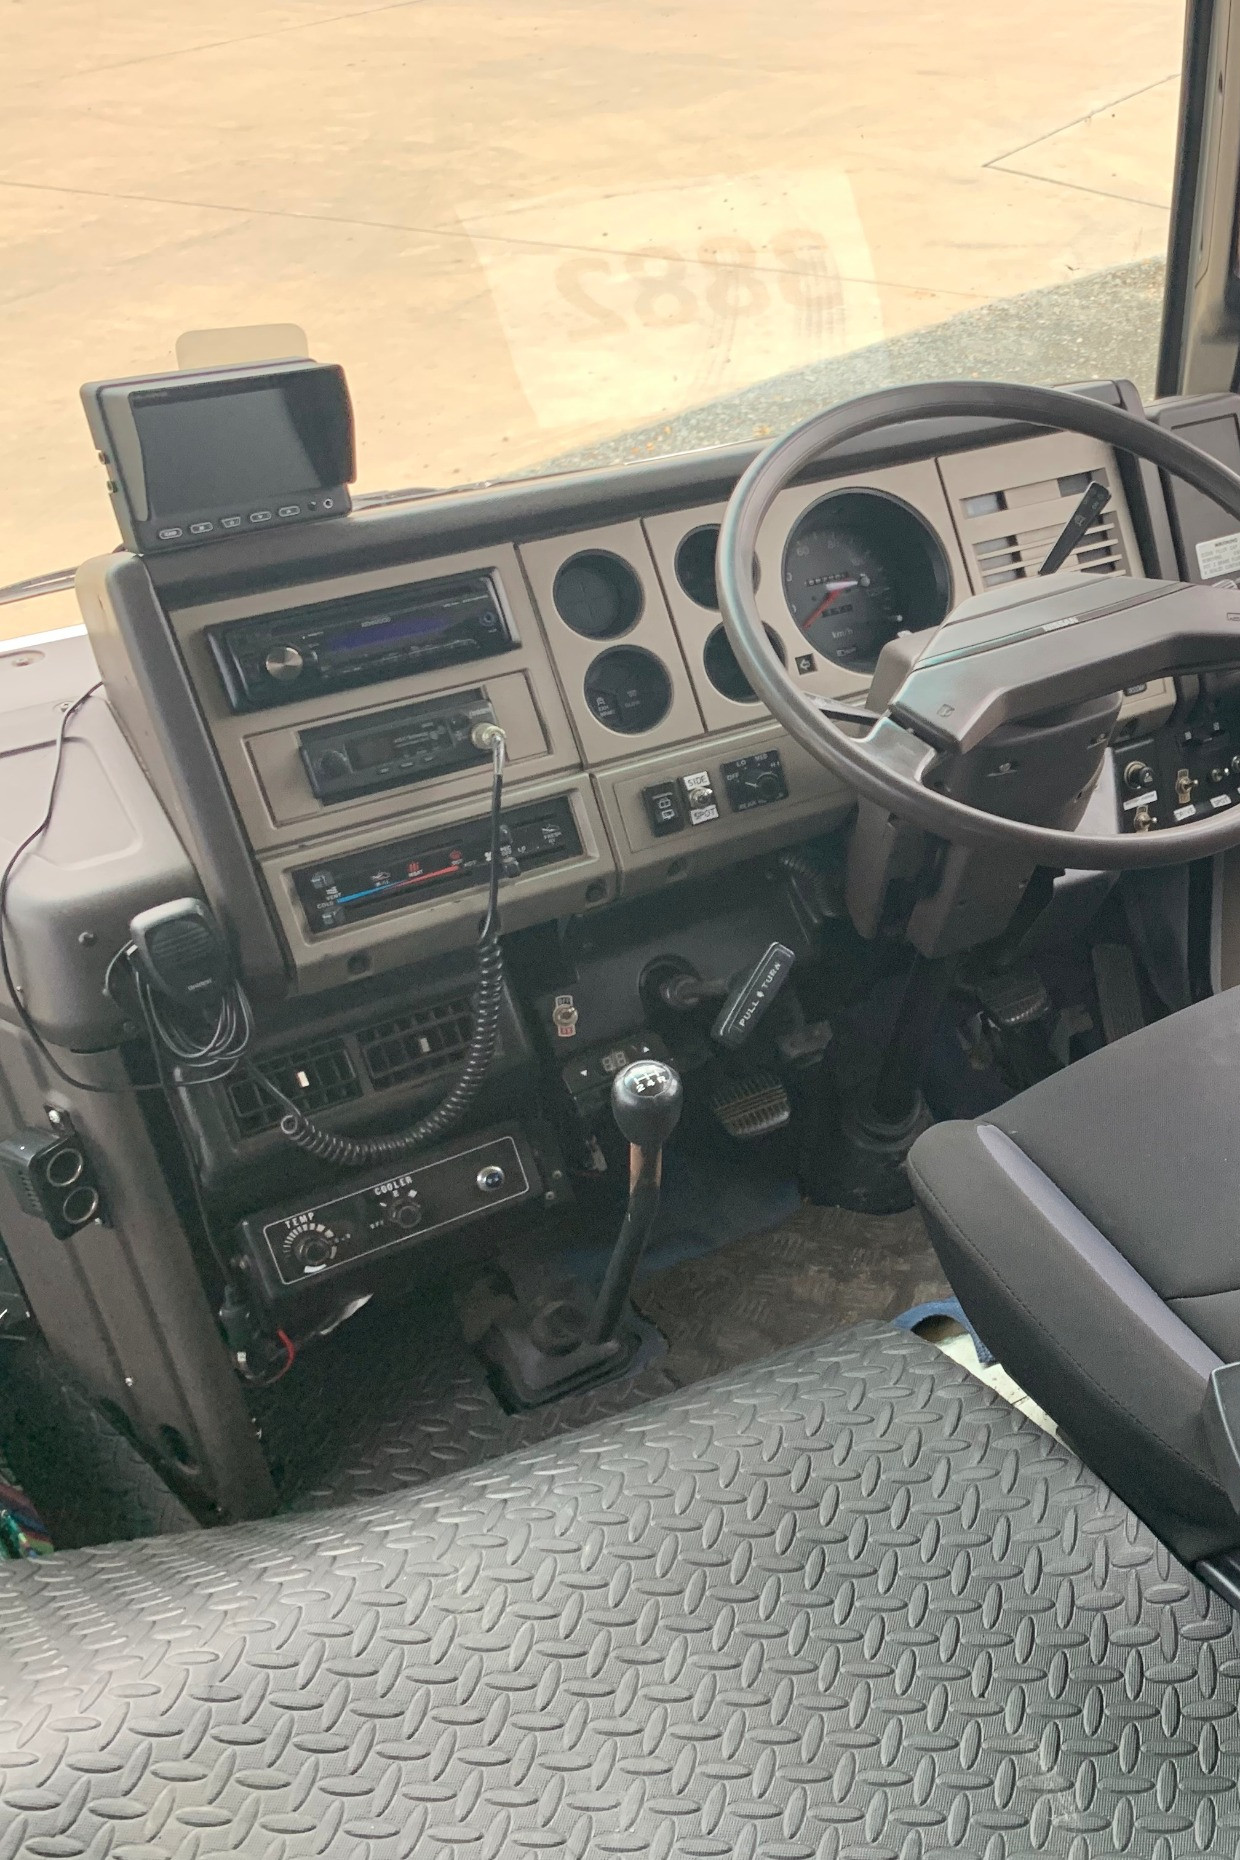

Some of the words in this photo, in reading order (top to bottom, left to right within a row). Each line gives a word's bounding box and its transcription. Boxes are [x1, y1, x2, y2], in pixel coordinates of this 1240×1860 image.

[687, 775, 707, 787] SIDE
[694, 808, 716, 821] SPOT
[738, 1000, 760, 1027] PULL
[761, 962, 781, 989] TURN
[374, 1175, 413, 1196] COOLER
[284, 1212, 315, 1229] TEMP
